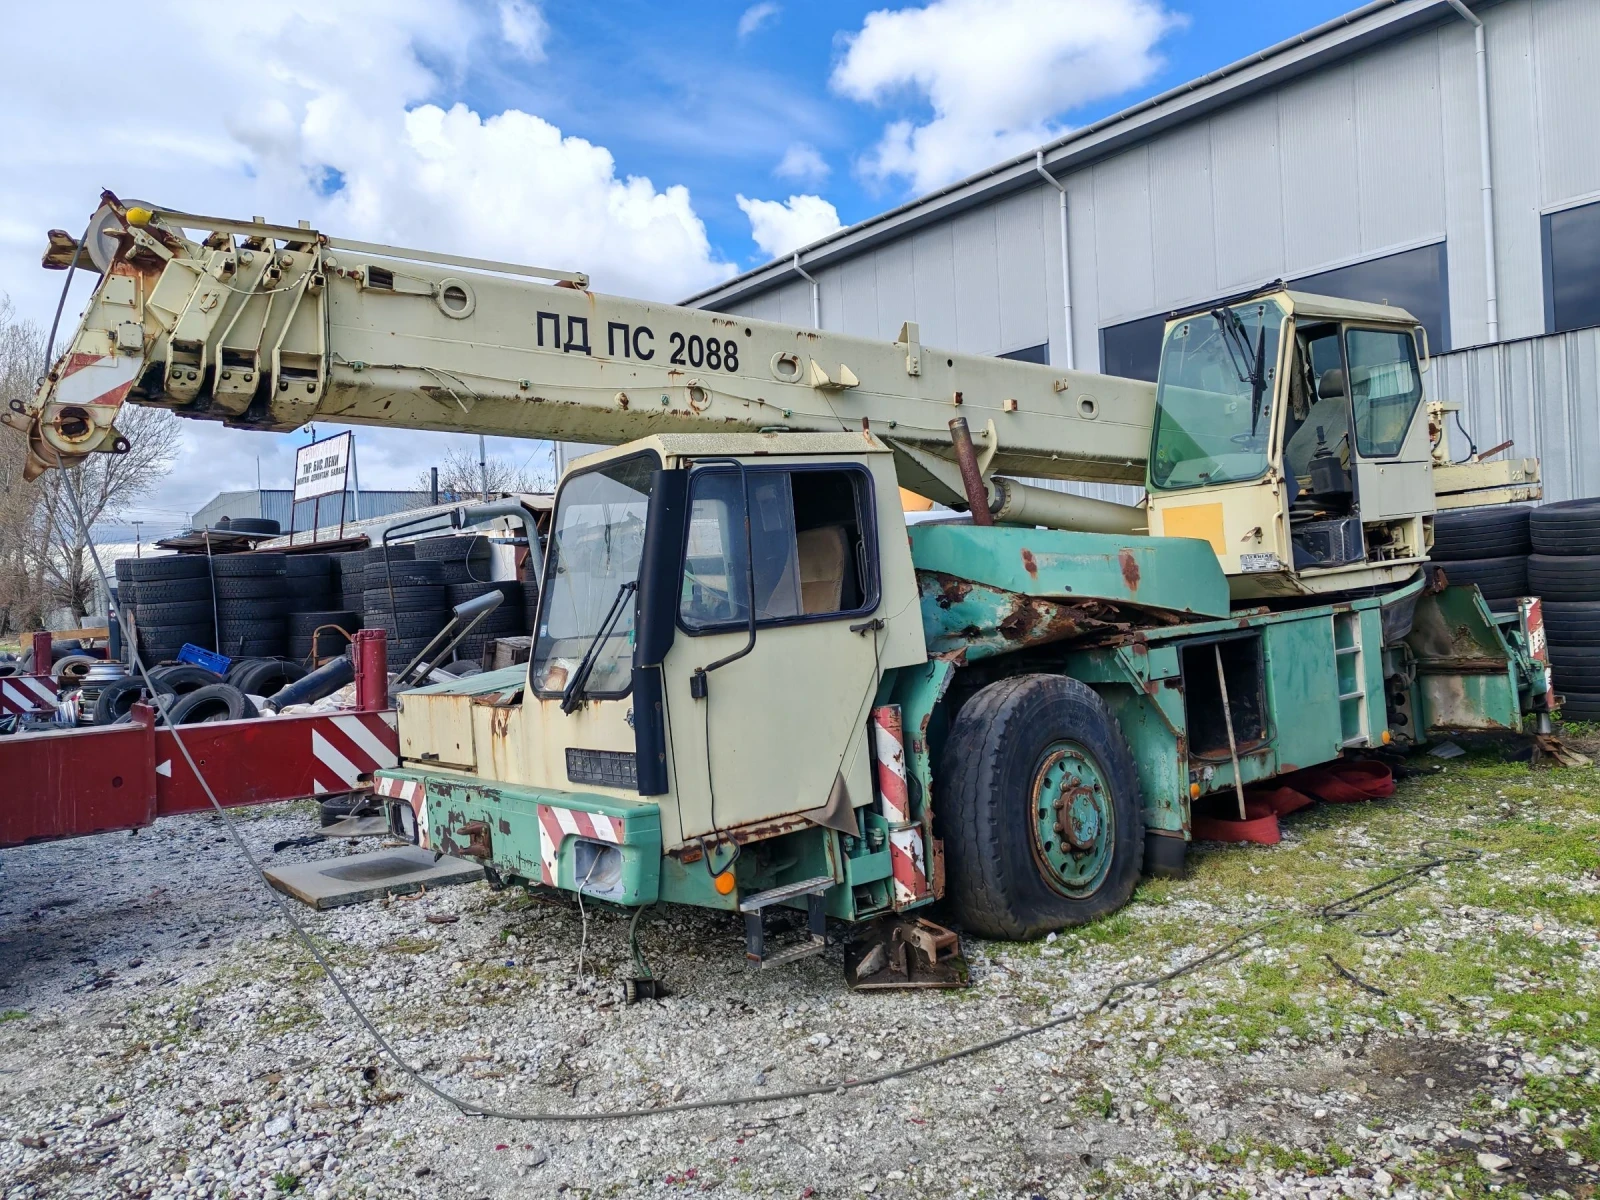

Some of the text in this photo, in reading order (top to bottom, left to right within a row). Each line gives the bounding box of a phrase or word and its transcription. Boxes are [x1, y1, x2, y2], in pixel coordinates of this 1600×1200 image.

[537, 311, 739, 373] ПД ПС 2088
